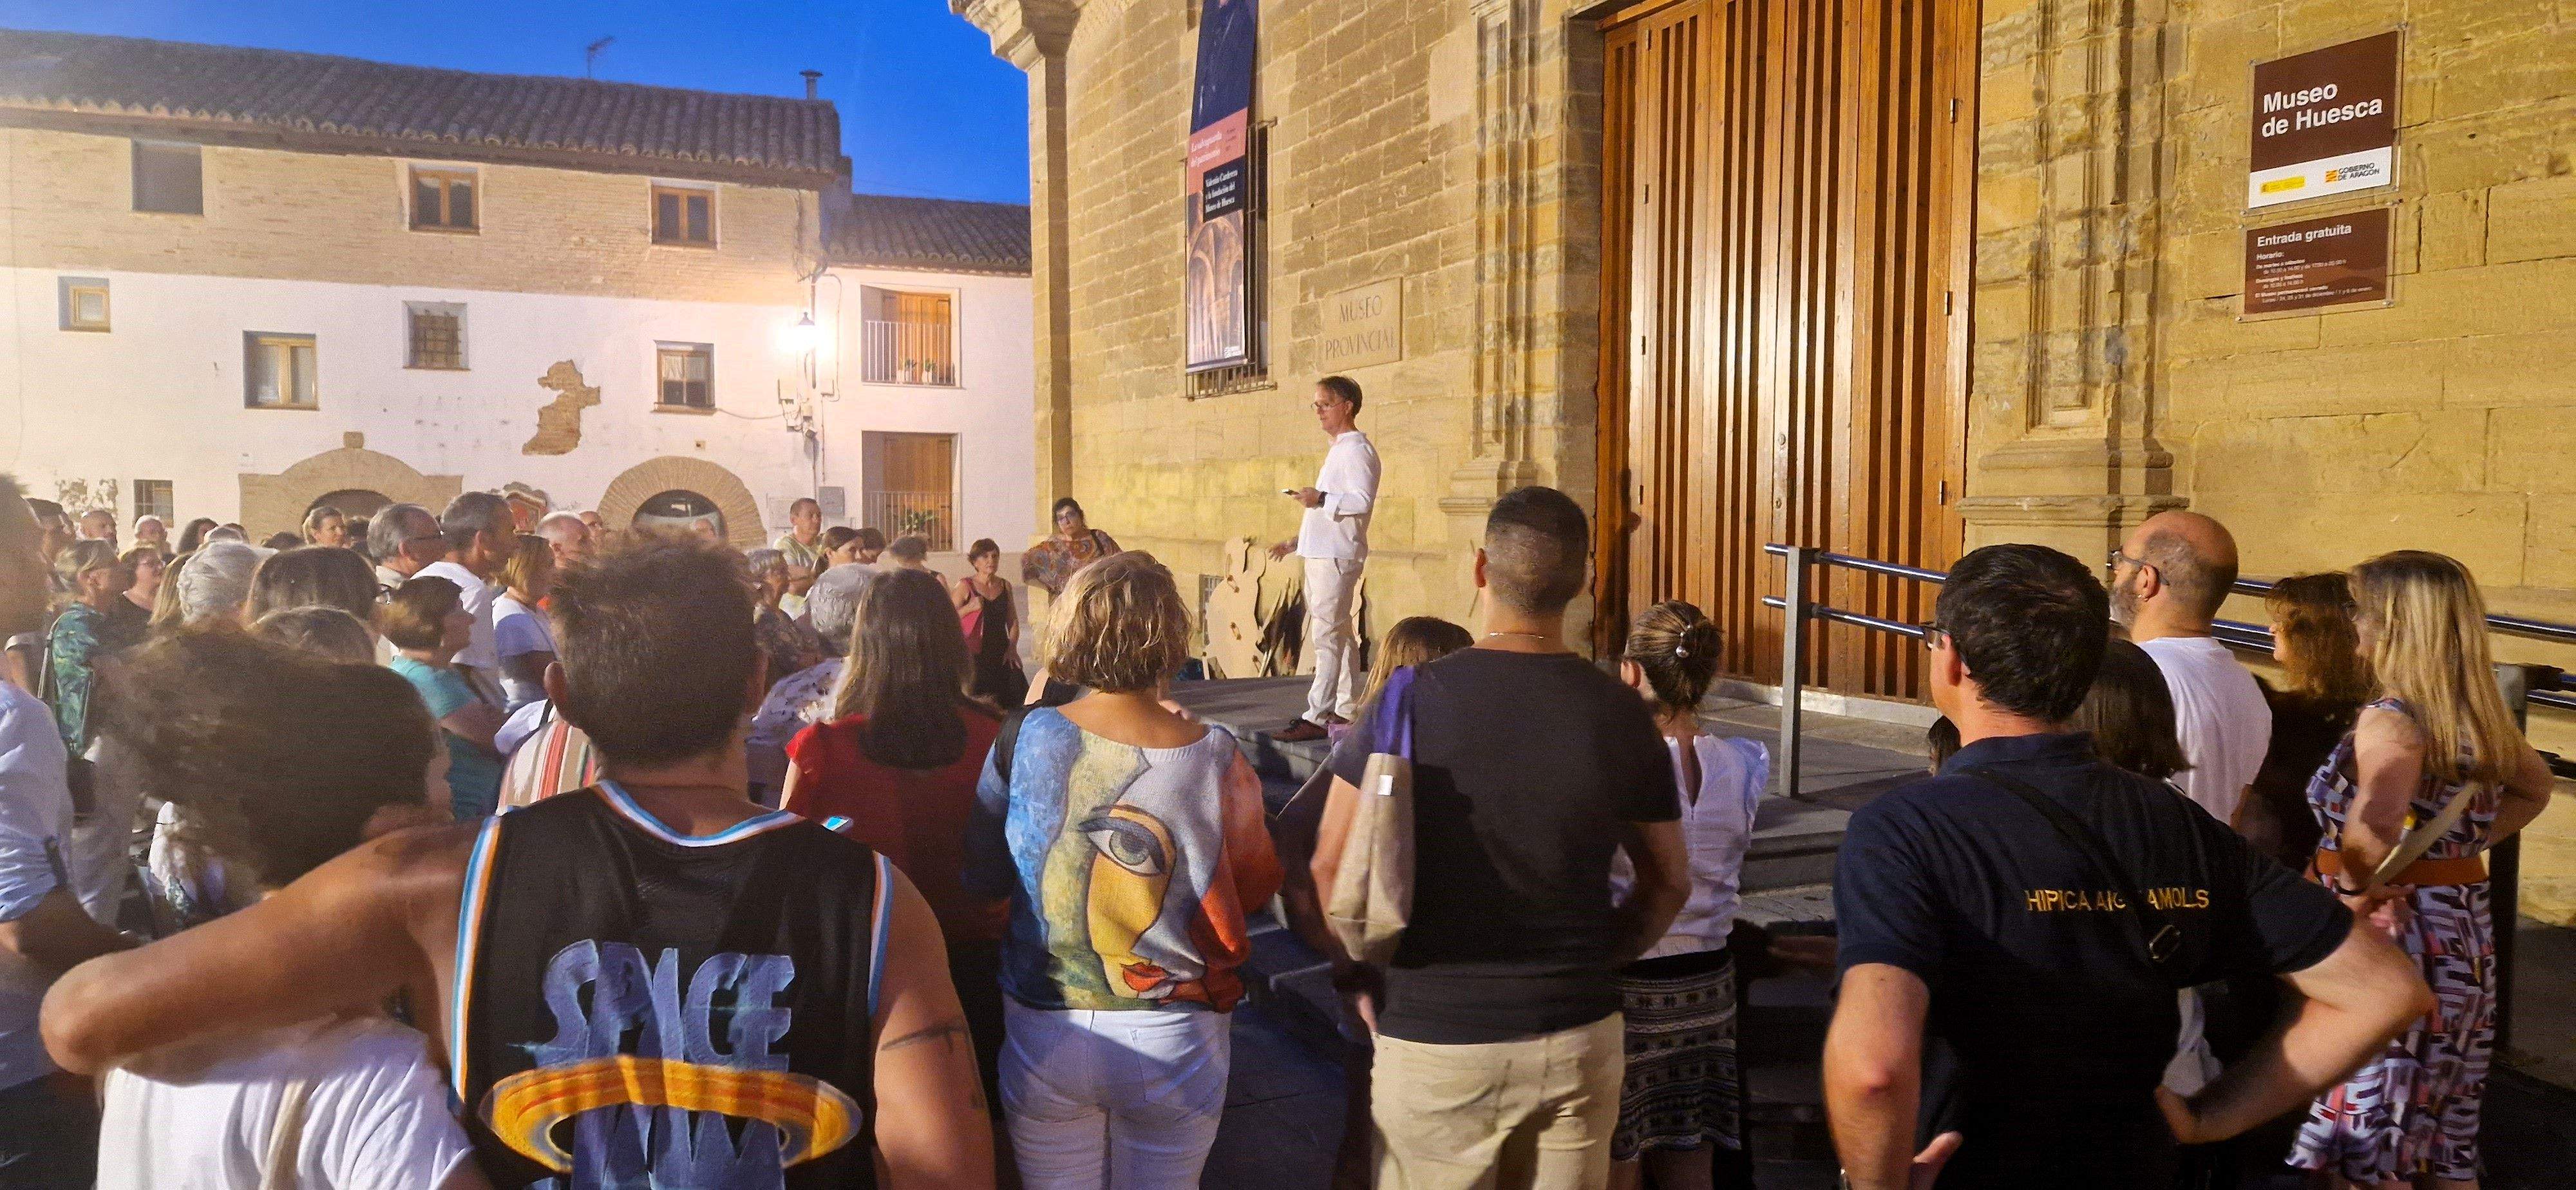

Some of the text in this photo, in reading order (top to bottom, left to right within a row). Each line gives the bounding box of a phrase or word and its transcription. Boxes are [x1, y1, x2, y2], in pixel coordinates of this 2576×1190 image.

[2263, 83, 2338, 113] Museo
[2262, 98, 2383, 138] de Huesca
[2338, 162, 2374, 174] GOBIERNO
[2257, 223, 2352, 247] Entrada gratuita
[2256, 251, 2284, 261] Horario:
[1340, 295, 1383, 322] MUSEO
[1325, 326, 1397, 360] PROVINCIAL
[2024, 889, 2092, 911] HIPICA
[533, 938, 795, 1073] SPACE
